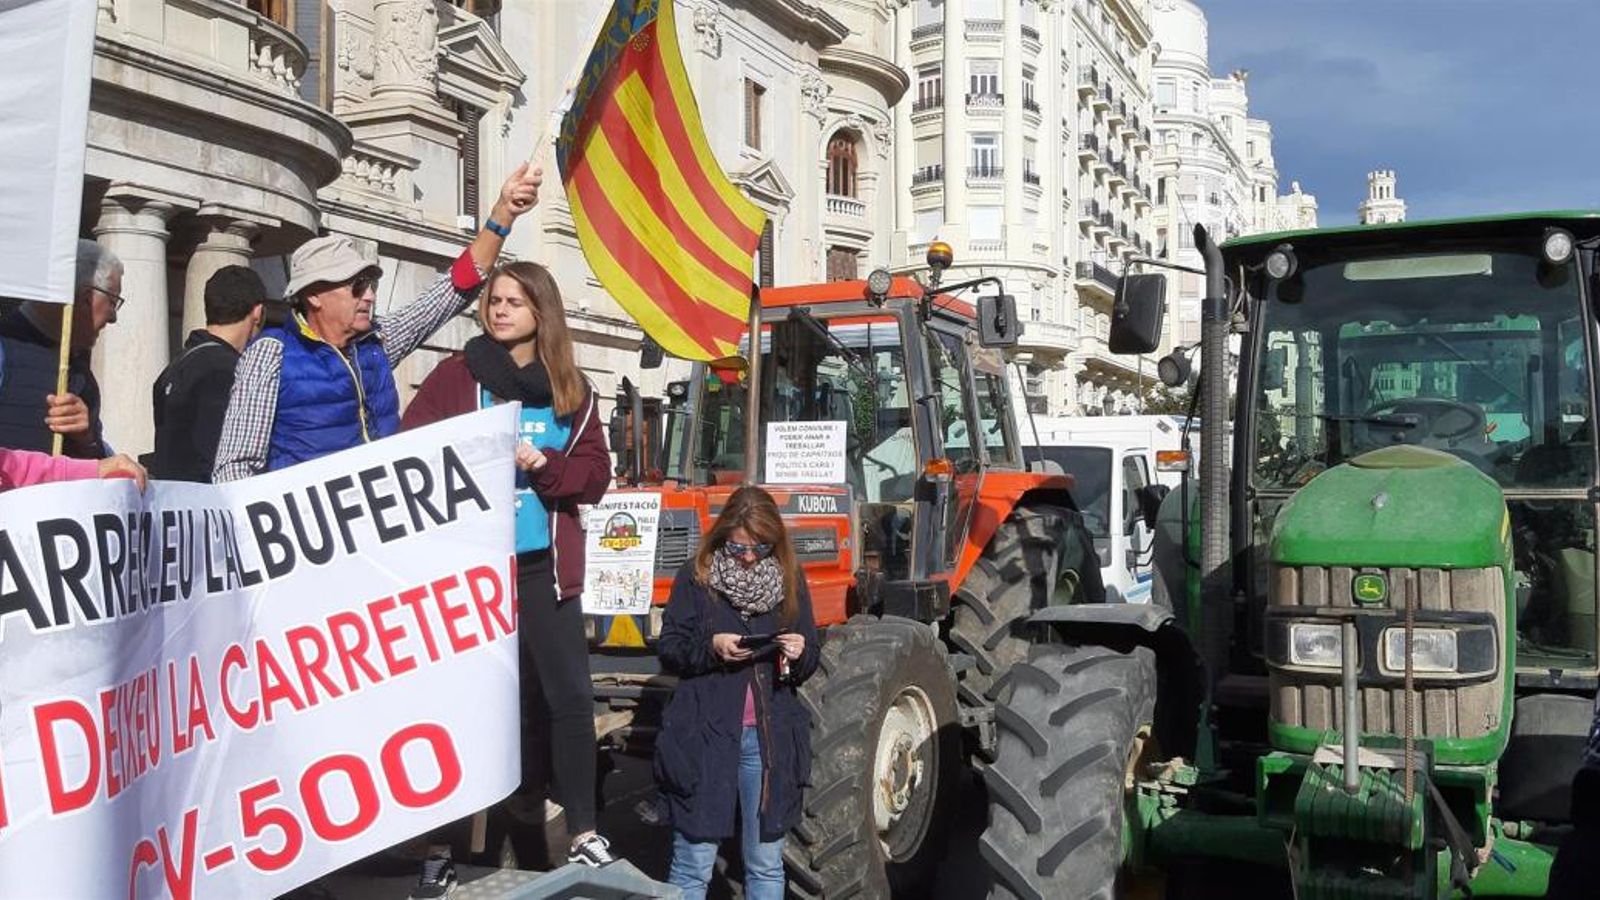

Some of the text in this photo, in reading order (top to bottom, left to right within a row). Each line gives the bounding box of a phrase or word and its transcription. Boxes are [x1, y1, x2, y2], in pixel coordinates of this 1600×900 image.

[774, 425, 798, 433] VOLEM
[785, 442, 826, 450] TREBALLAR
[204, 445, 491, 593] L'ALBUFERA
[798, 496, 837, 513] KUBOTA
[33, 667, 161, 816] DEIXEU
[169, 655, 216, 754] LA
[128, 723, 463, 900] CV-500
